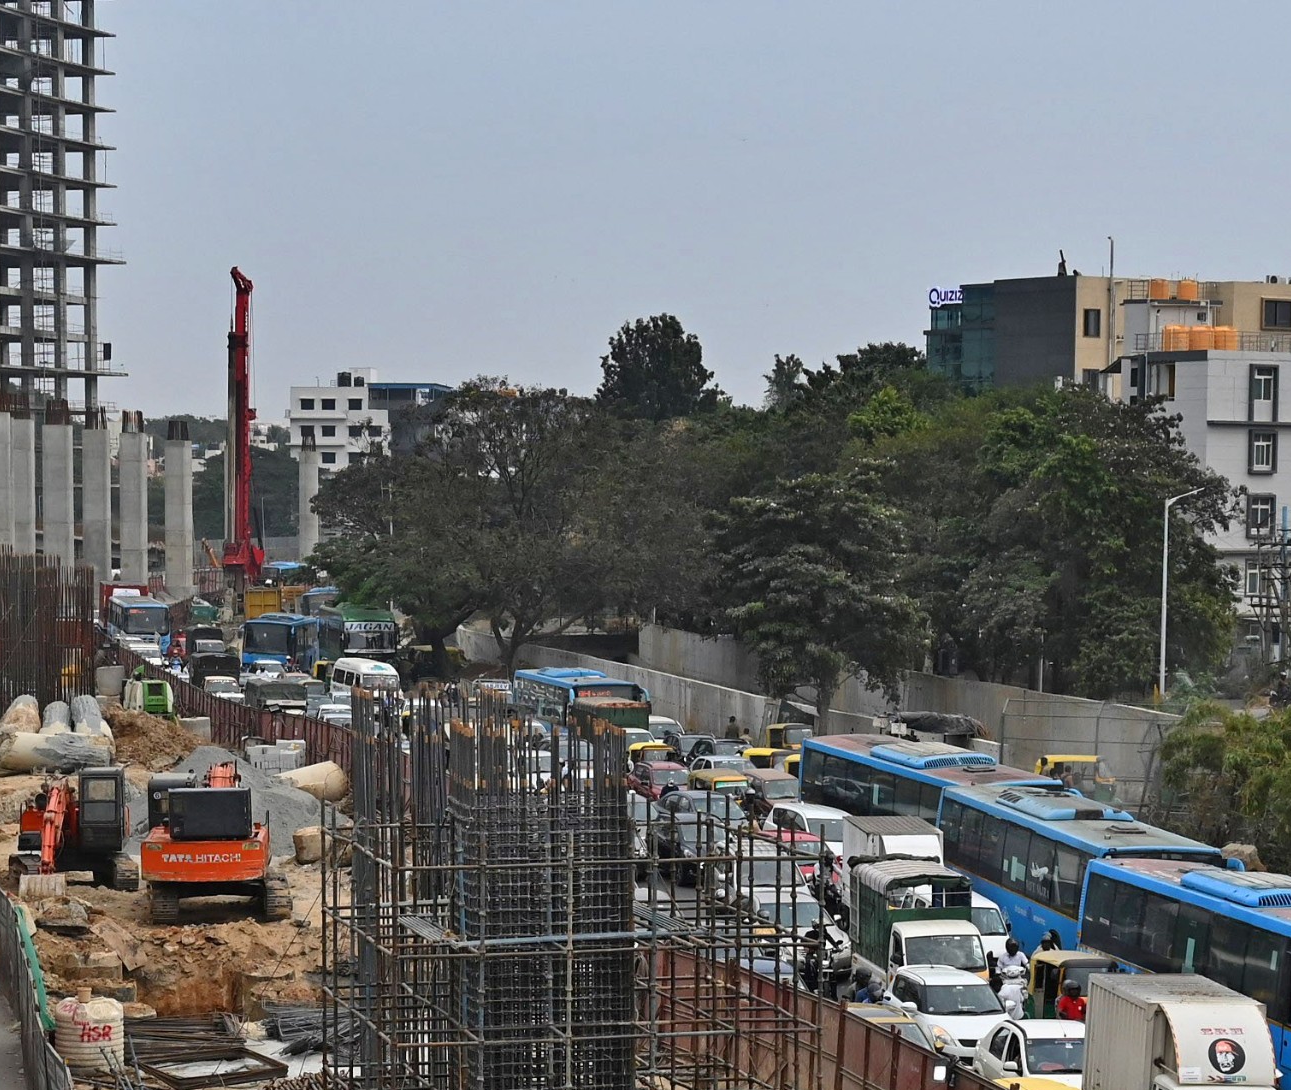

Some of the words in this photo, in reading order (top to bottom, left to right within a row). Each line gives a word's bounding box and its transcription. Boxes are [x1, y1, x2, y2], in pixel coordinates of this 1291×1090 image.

[346, 622, 393, 631] JAGAN
[161, 853, 193, 863] TATA
[195, 853, 241, 863] HITACHI
